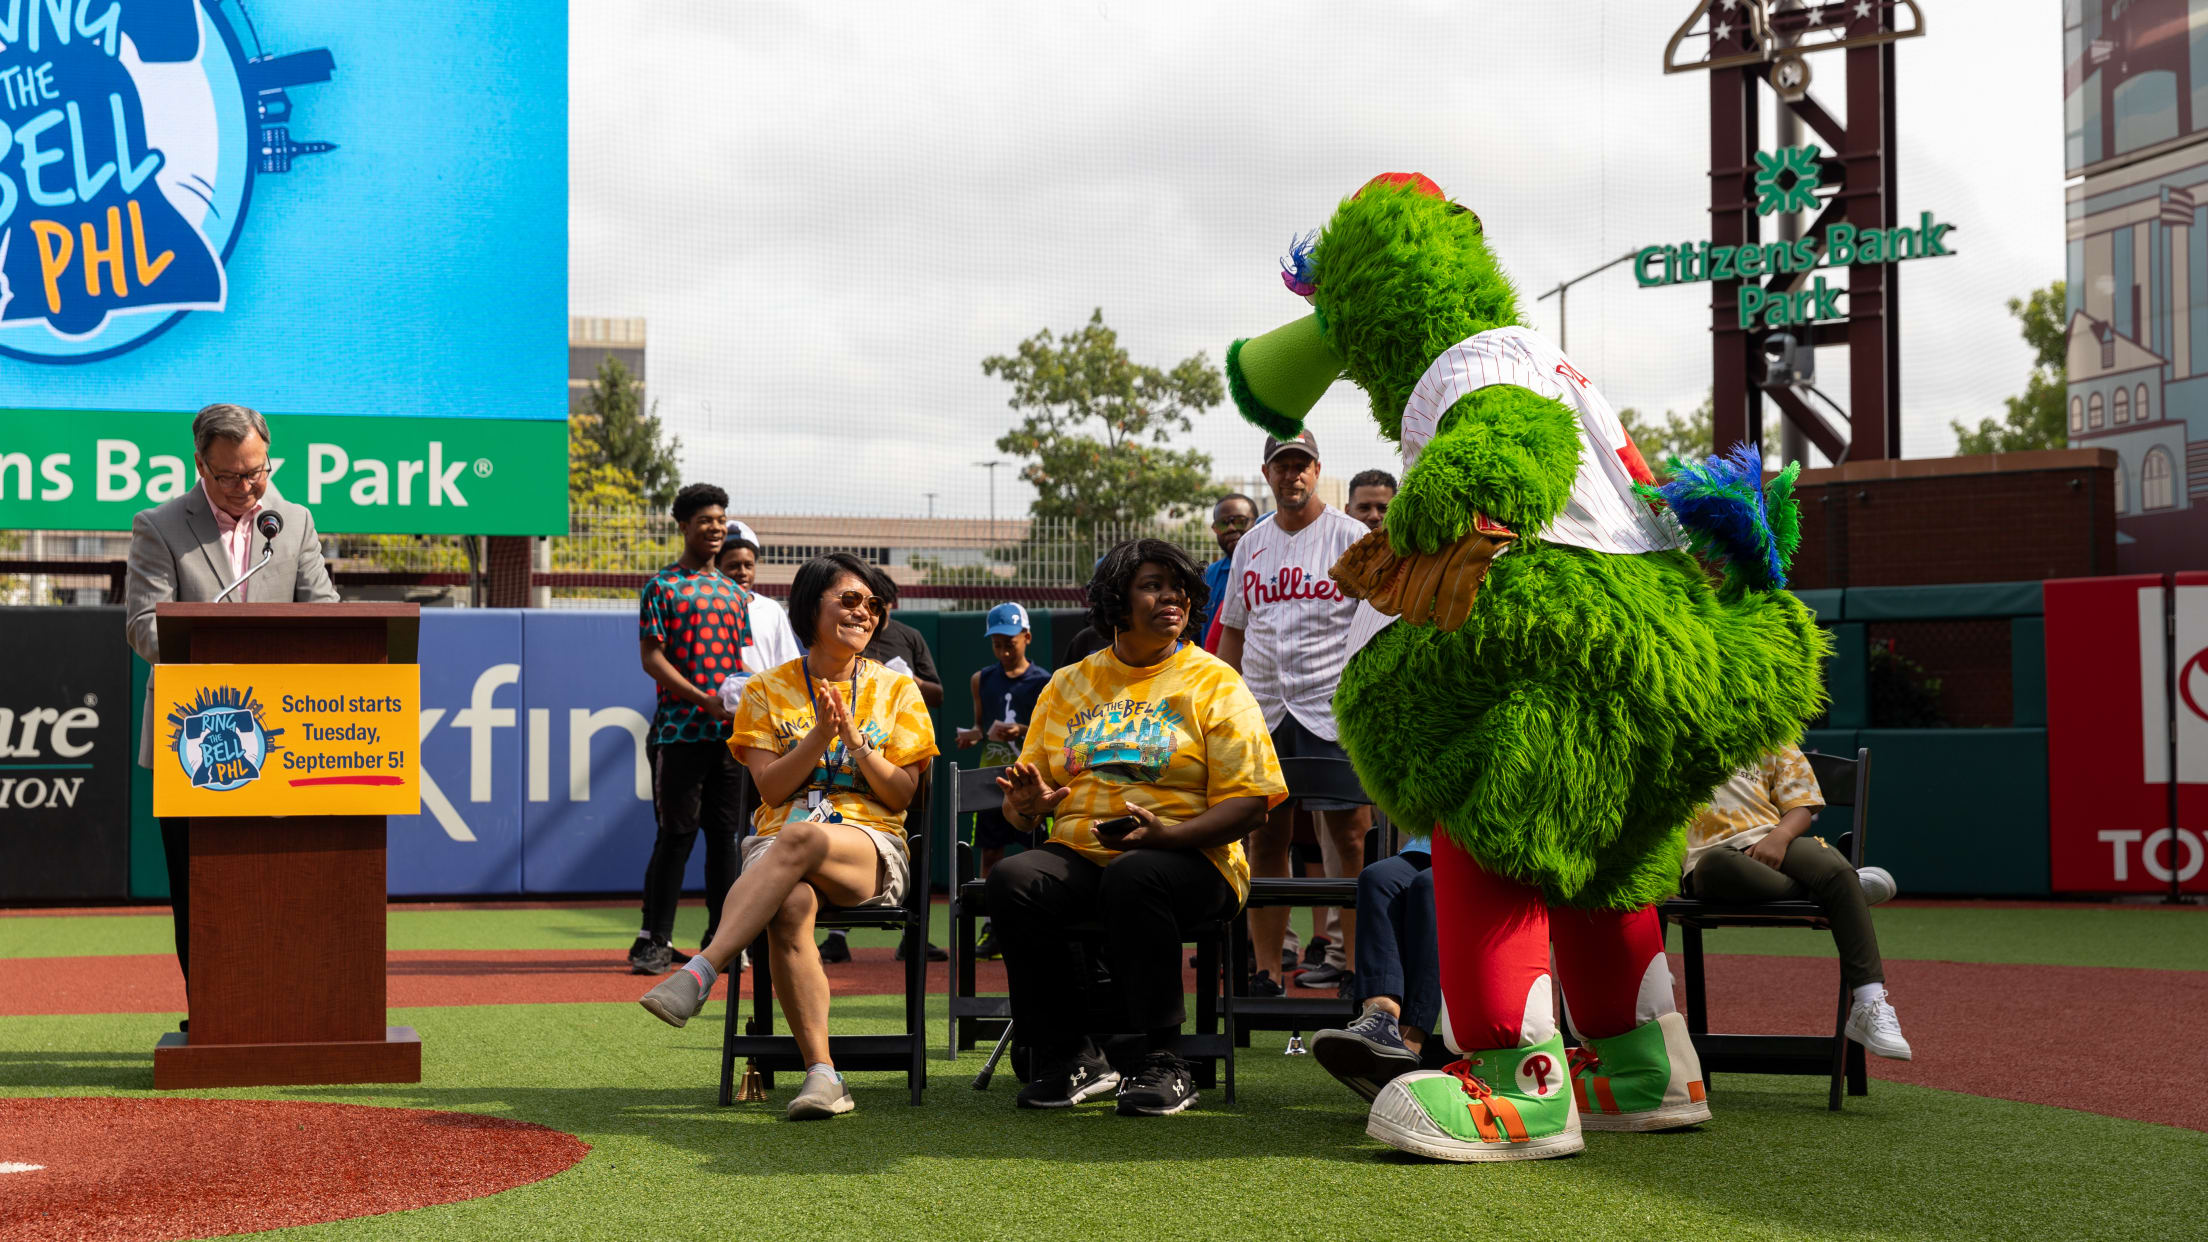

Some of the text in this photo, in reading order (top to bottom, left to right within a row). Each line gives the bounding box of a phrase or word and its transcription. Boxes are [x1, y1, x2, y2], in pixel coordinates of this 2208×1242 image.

[0, 61, 60, 110] THE
[30, 199, 175, 314] PHL
[1634, 211, 1951, 288] Citizens Bank
[1738, 276, 1844, 330] Park
[282, 694, 402, 713] School starts
[1066, 704, 1104, 734] RING
[1104, 700, 1124, 712] THE
[1152, 698, 1185, 733] PHL
[202, 713, 237, 733] RING
[207, 733, 224, 744] THE
[302, 722, 381, 745] Tuesday,
[775, 715, 811, 748] RING
[200, 738, 246, 768] BELL
[283, 750, 404, 774] September 5!
[216, 759, 249, 782] PHL
[2098, 827, 2208, 882] TO
